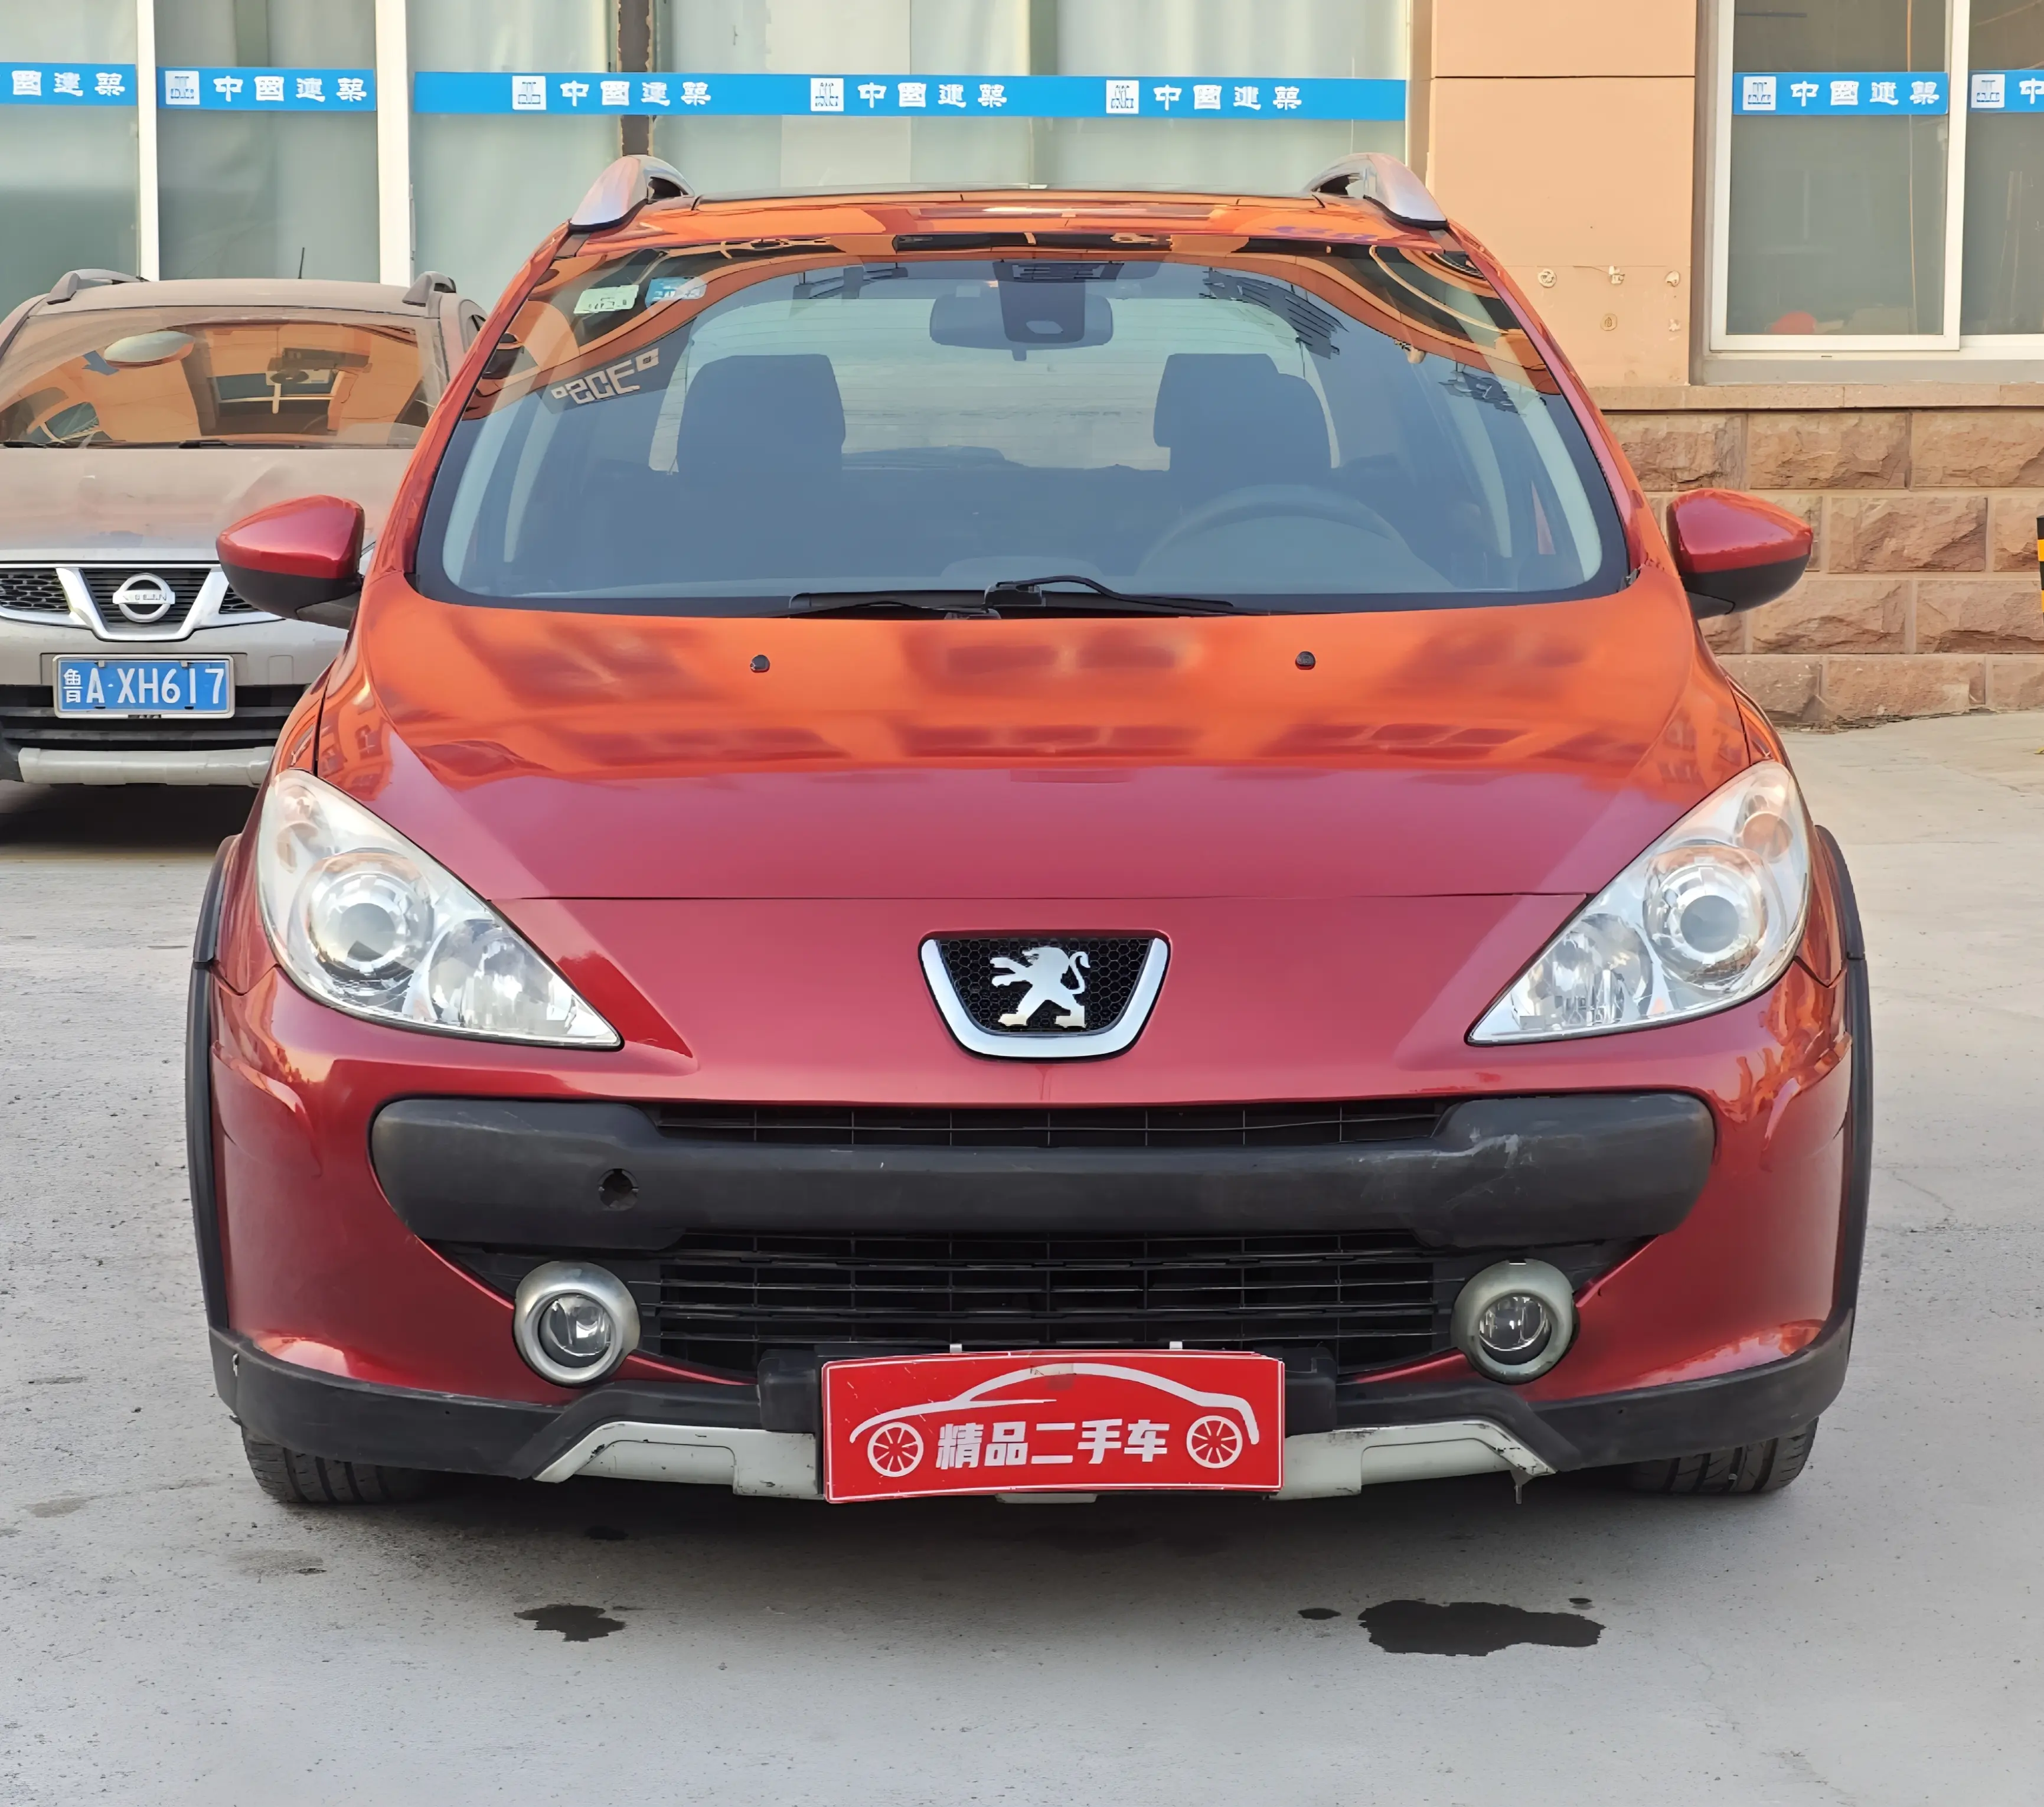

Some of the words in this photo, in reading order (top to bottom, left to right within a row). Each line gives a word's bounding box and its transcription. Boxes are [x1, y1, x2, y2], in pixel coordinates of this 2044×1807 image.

[936, 1419, 1169, 1469] 精品二手车
